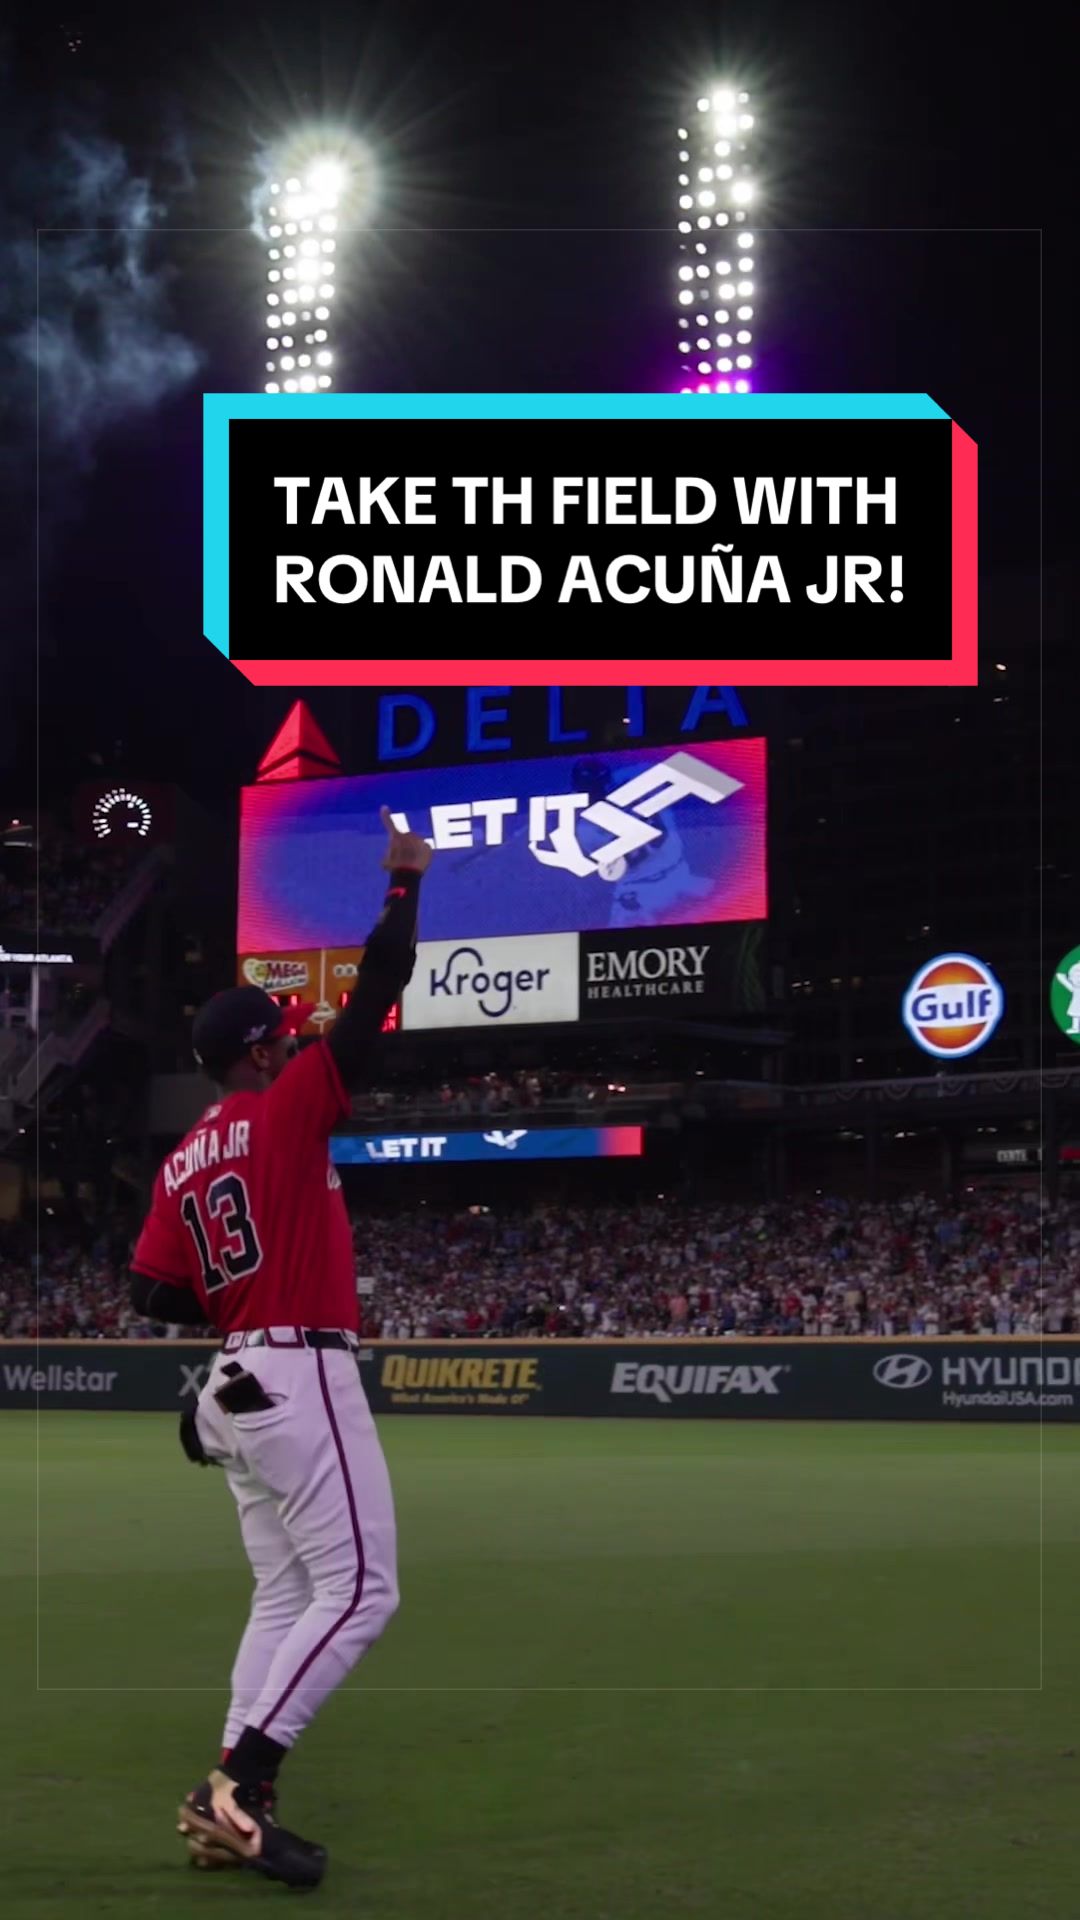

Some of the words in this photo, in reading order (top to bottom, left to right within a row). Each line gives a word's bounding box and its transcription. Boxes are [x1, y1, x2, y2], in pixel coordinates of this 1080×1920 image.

[587, 946, 710, 982] EMORY
[430, 947, 550, 1018] Kroger
[587, 979, 705, 999] HEALTHCARE
[911, 989, 992, 1021] Gulf
[163, 1128, 220, 1197] ACUÑA
[223, 1119, 250, 1160] JR
[366, 1138, 419, 1159] LET
[420, 1136, 447, 1158] IT
[181, 1171, 263, 1294] 13
[3, 1365, 118, 1392] Wellstar
[381, 1354, 539, 1389] QUIKRETE
[610, 1362, 783, 1402] EQUIFAX
[942, 1357, 1080, 1386] HYUND
[942, 1390, 1074, 1408] HyundaiUSA.com
